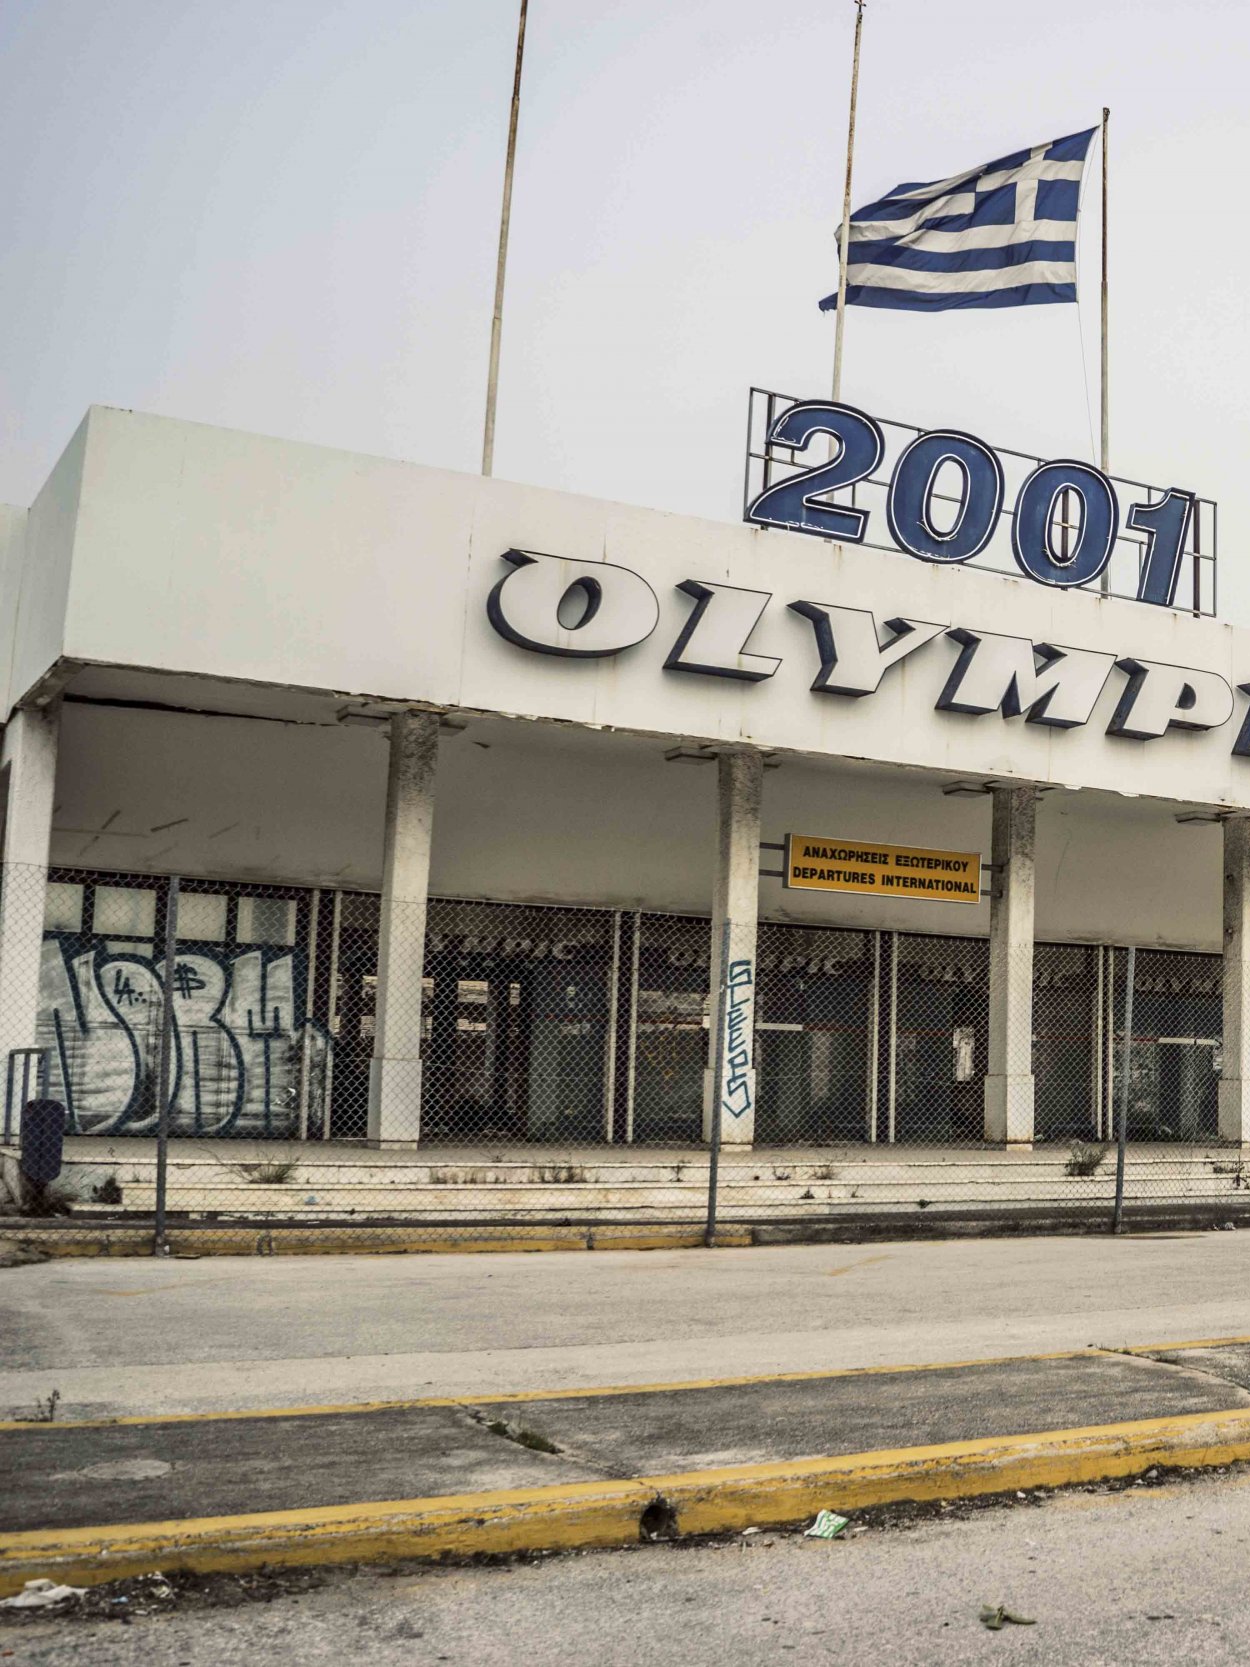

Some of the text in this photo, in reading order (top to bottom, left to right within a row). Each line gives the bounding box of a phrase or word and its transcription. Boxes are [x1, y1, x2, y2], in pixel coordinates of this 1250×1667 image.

[745, 399, 1196, 606] 2001
[793, 866, 977, 894] DEPARTURES INTERNATIONAL
[803, 846, 969, 873] ΑΝΑΧΩΡΗΣΕΙΣ ΕΞΩΤΕΡΙΚΟΥ
[722, 959, 753, 1119] SLEEPS
